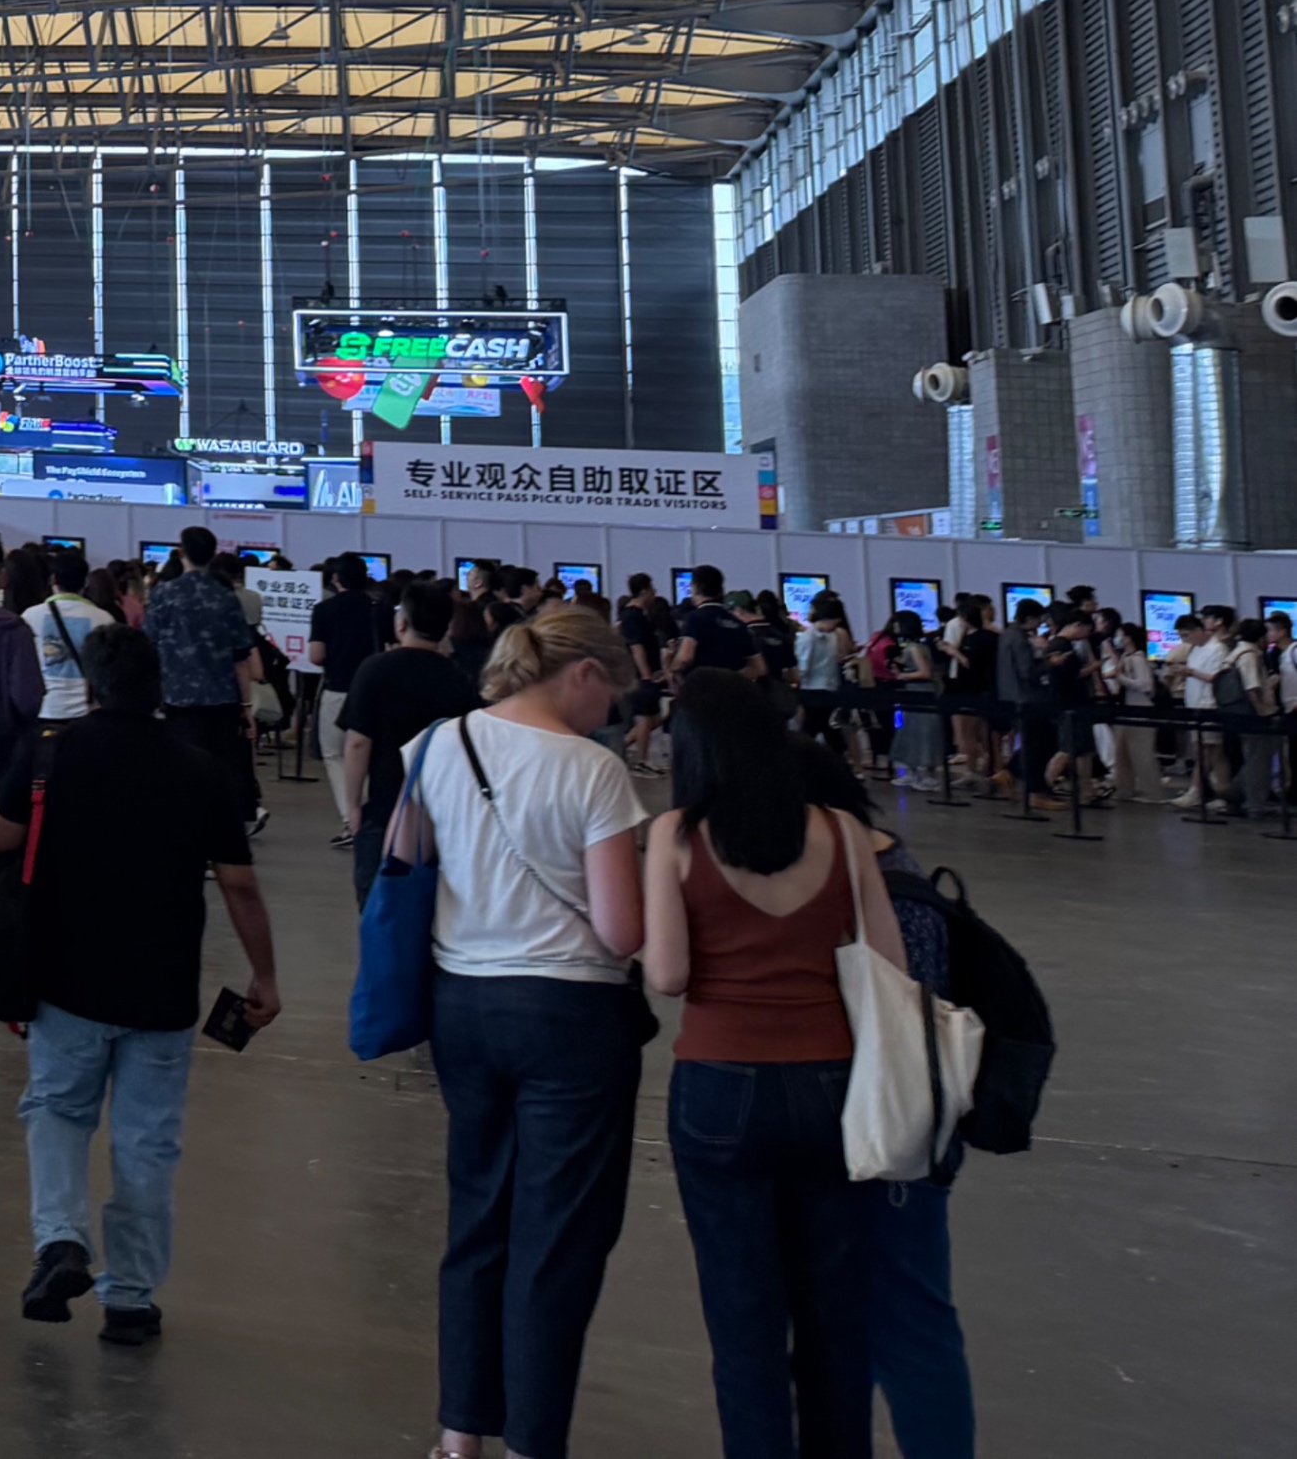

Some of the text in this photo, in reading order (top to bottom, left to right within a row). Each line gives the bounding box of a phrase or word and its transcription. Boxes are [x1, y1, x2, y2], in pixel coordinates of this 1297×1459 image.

[372, 336, 530, 359] FREECASH
[4, 353, 96, 369] PartnerBoost
[194, 438, 305, 455] WASABICARD
[406, 459, 725, 498] 专业观众自助取证区
[440, 490, 494, 502] SERVICE
[497, 492, 528, 503] PASS
[531, 493, 563, 504] PICK
[565, 495, 584, 505] UP
[586, 495, 614, 507] FOR
[616, 496, 660, 508] TRADE
[663, 498, 727, 510] VISITORS
